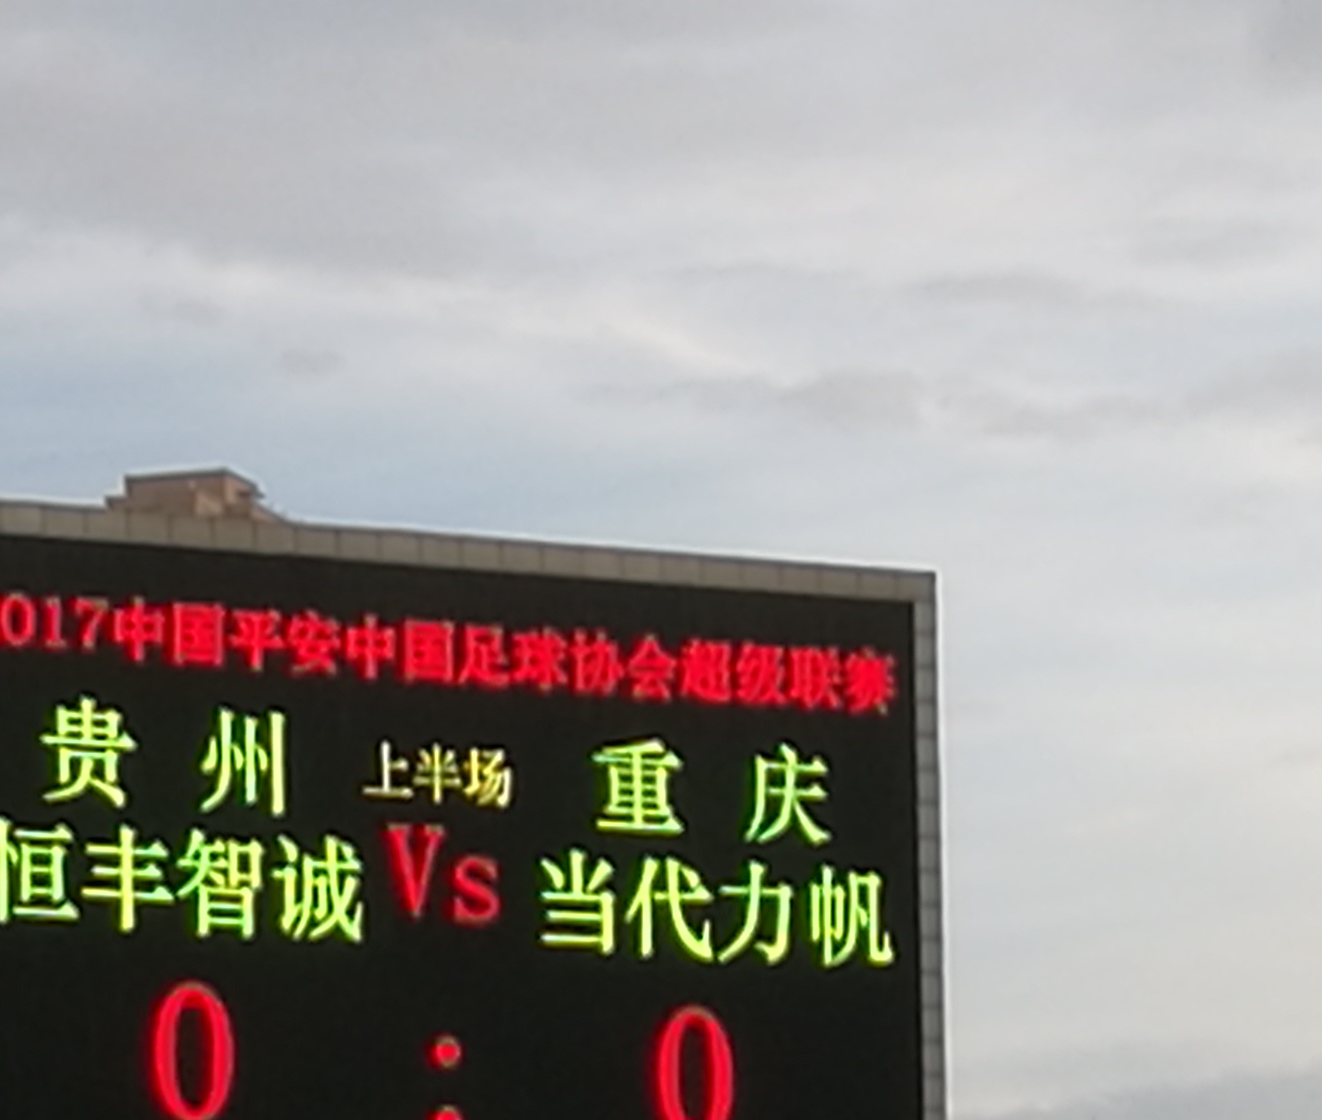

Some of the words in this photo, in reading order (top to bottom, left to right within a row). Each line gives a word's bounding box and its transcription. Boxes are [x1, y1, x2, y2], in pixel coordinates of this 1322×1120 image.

[363, 740, 513, 808] 上半场
[540, 850, 893, 966] 当代力帆
